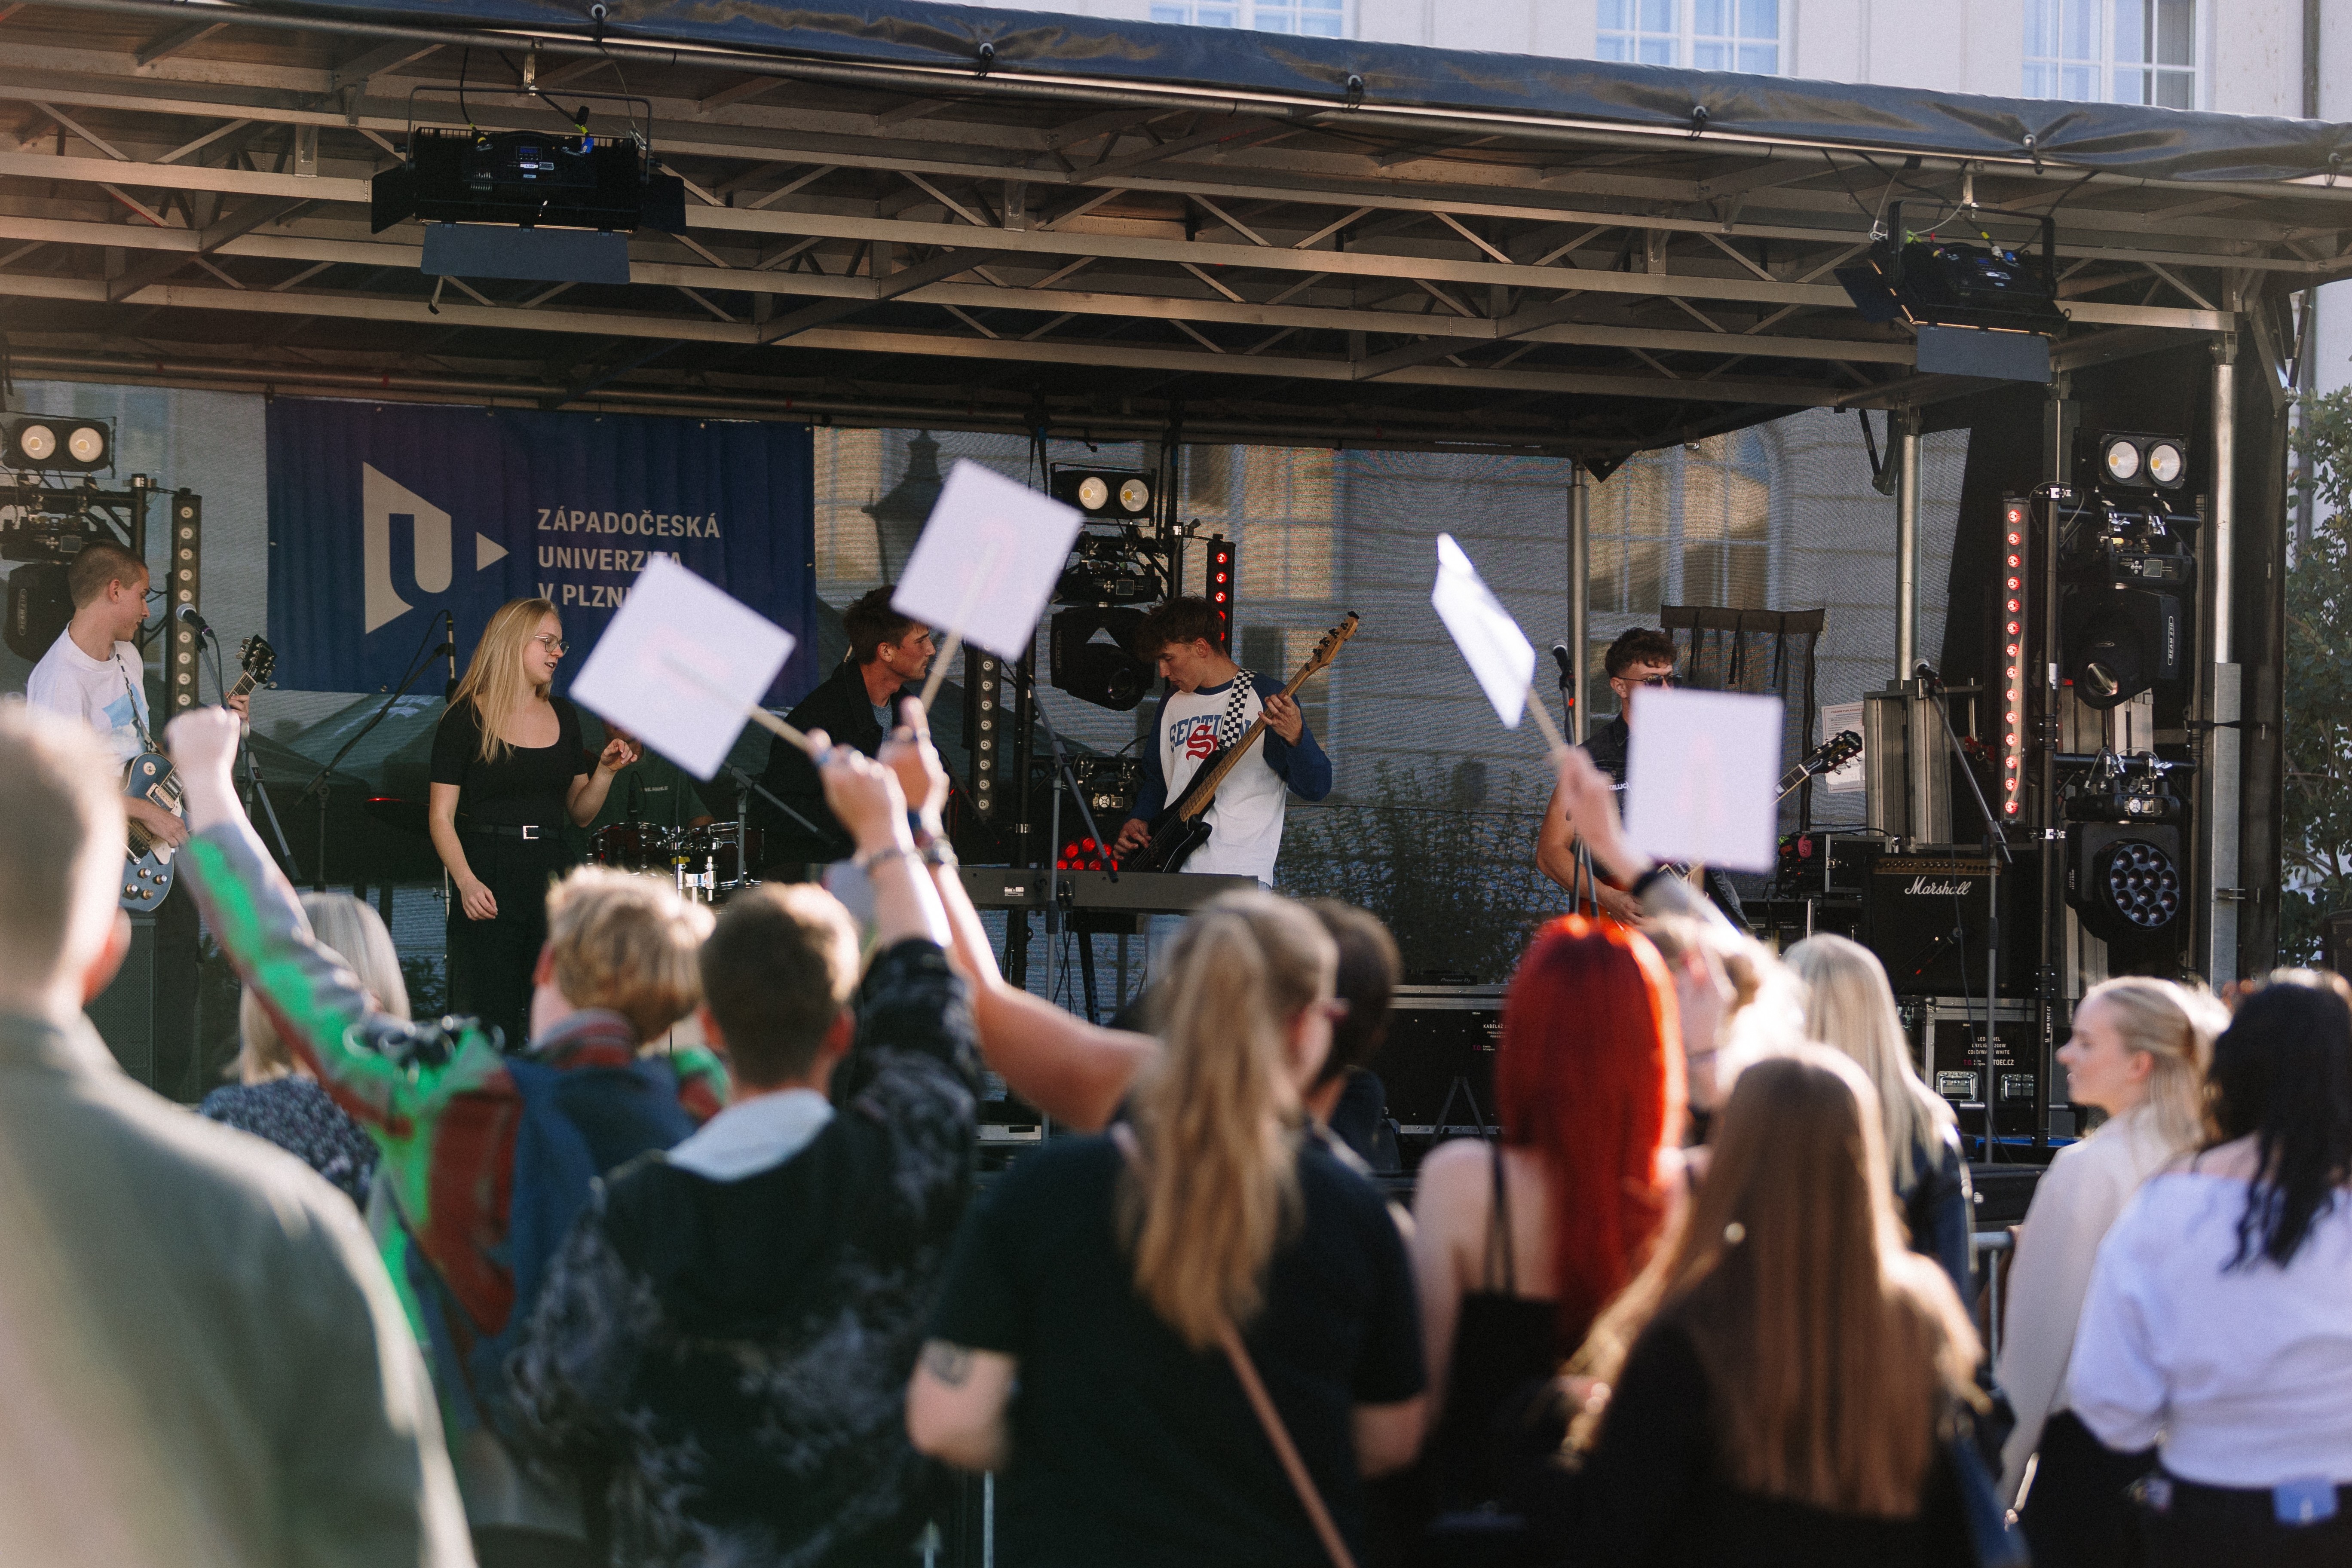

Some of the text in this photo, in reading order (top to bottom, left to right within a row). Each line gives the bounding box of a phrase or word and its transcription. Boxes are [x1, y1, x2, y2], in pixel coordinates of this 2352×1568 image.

[537, 505, 720, 538] ZÁPADOČESKÁ
[539, 583, 554, 600] V
[1169, 714, 1251, 753] SECTIN
[1607, 781, 1633, 794] TALLICA
[1904, 876, 1972, 895] Marshall
